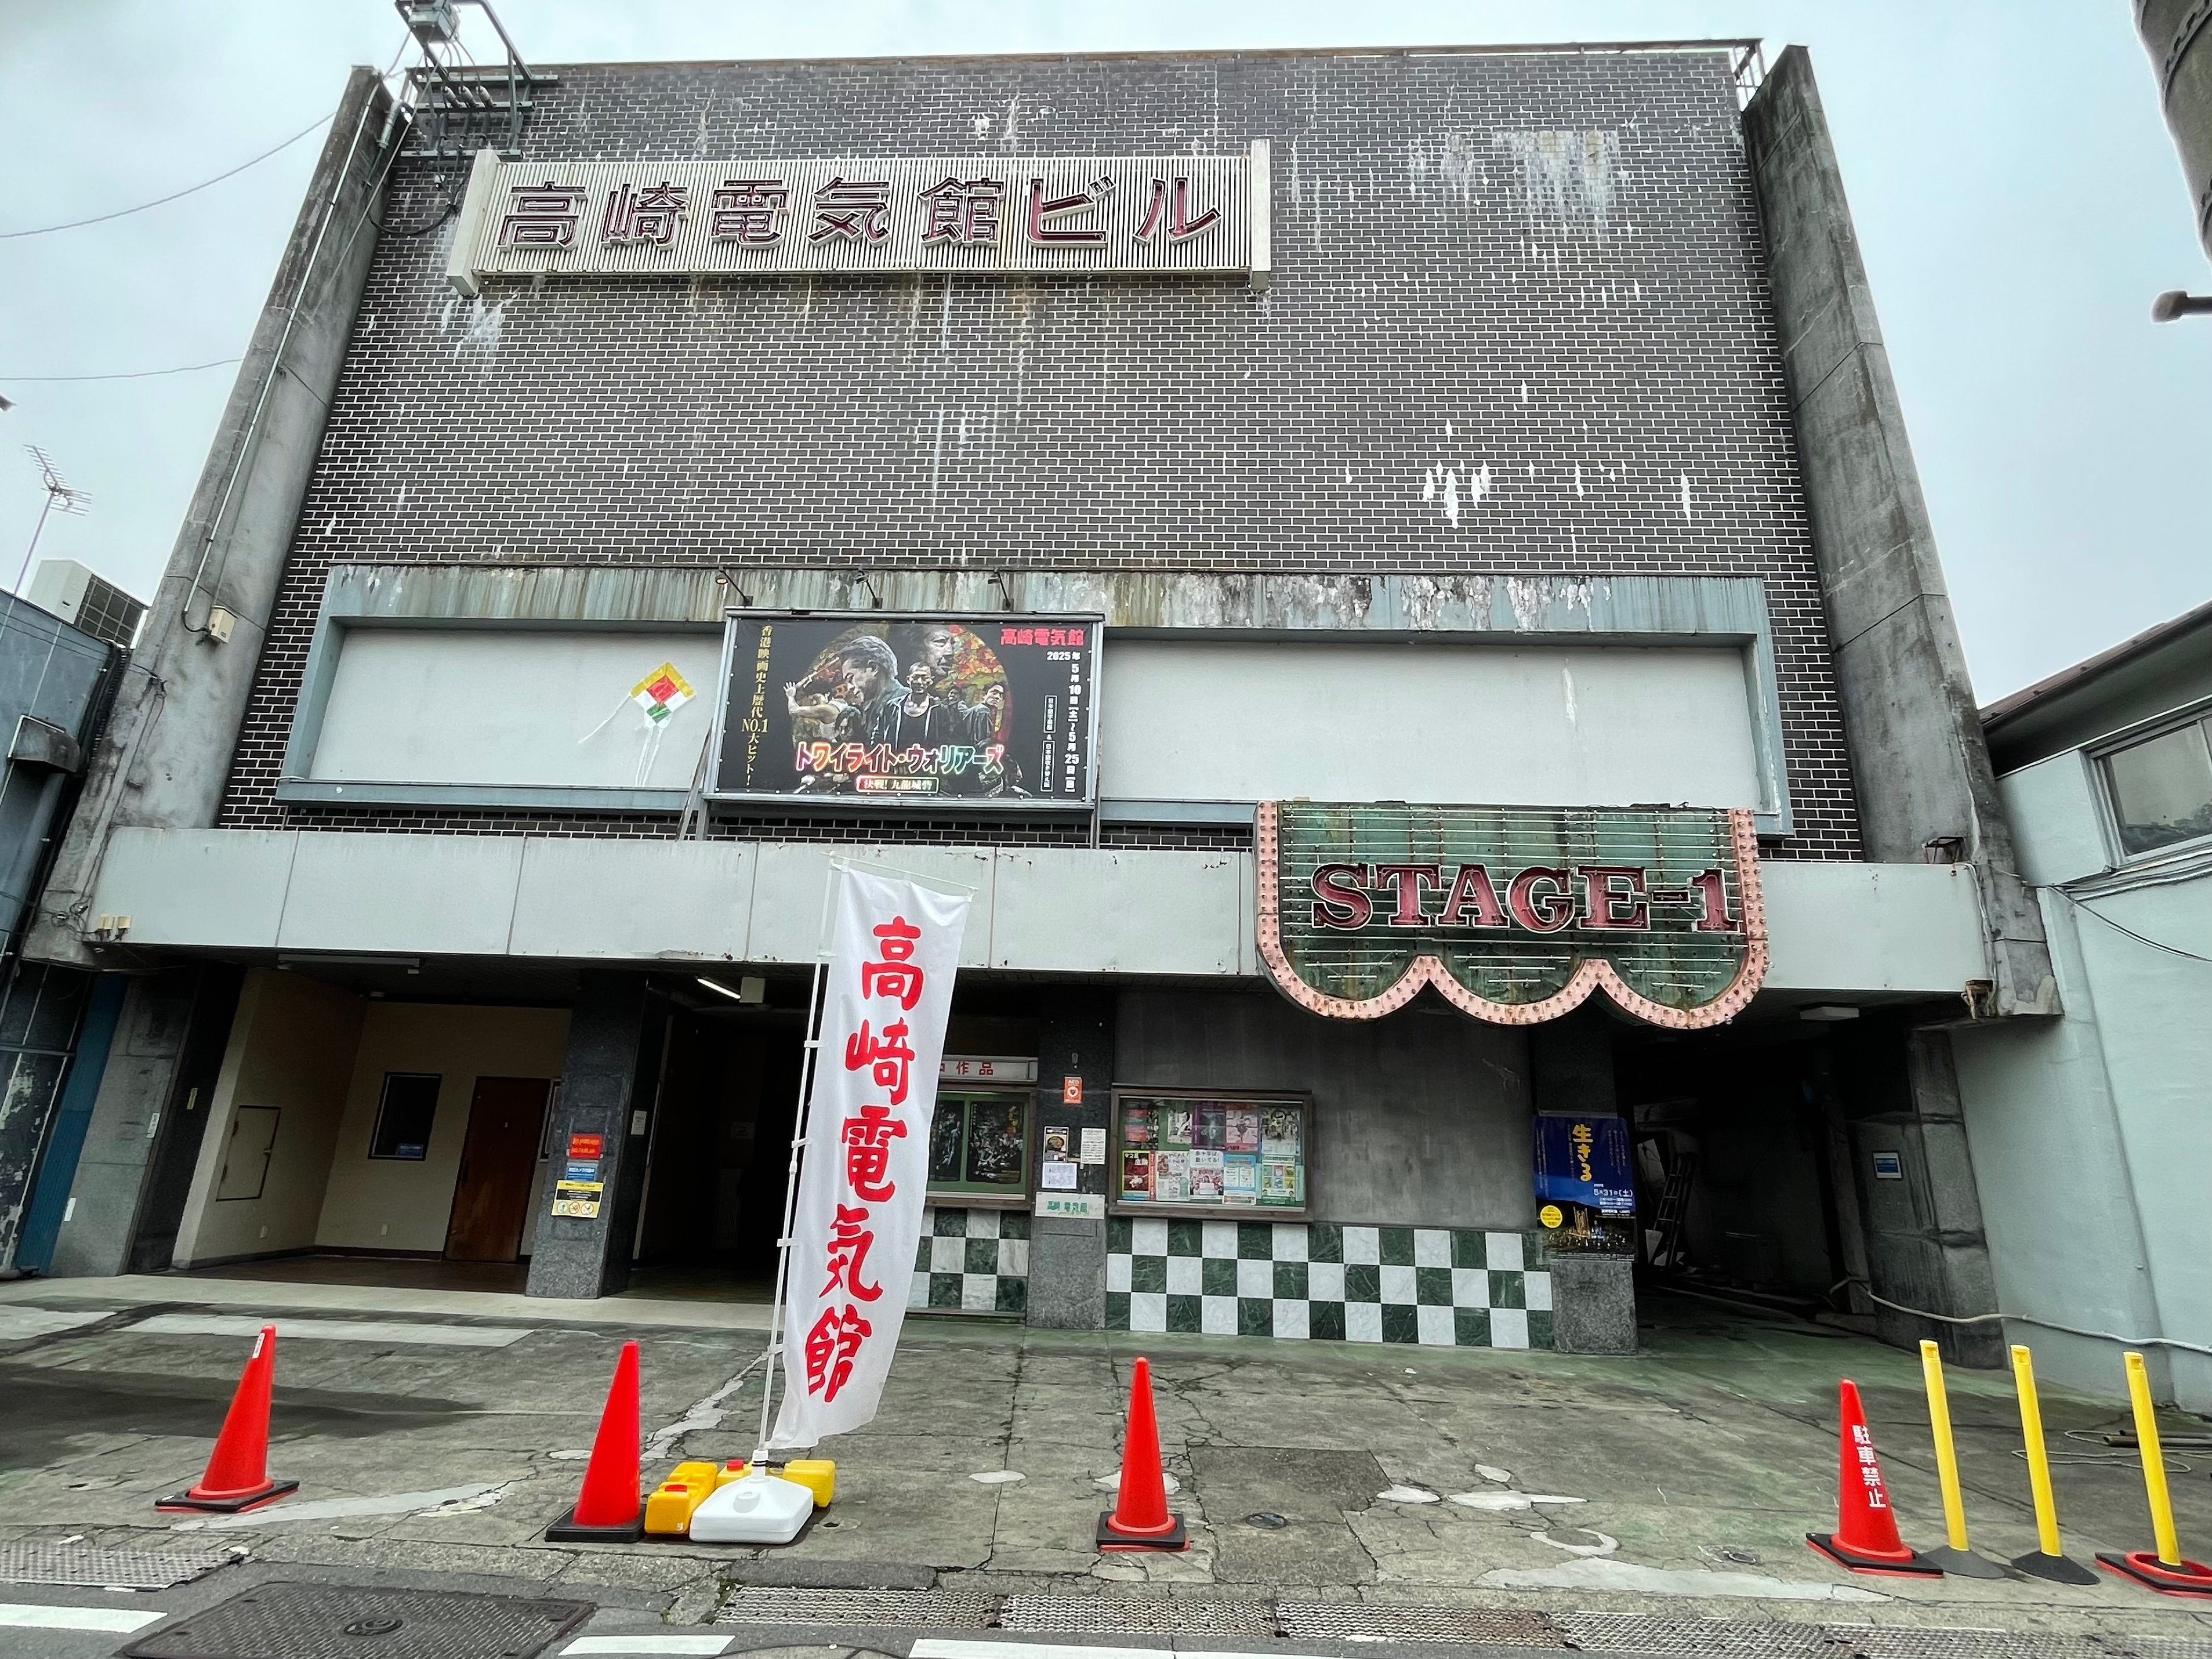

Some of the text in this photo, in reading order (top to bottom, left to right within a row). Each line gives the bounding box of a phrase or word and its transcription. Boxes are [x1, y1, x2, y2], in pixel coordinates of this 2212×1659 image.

[496, 175, 1221, 253] 高崎電気館ビル
[1000, 628, 1084, 646] 高崎電気館
[1047, 651, 1080, 661] 2025年
[796, 741, 1005, 775] トワイライト・ウォリアーズ
[1310, 863, 1740, 934] STAGE-1
[804, 916, 924, 1403] 高崎電気館
[1572, 1124, 1593, 1182] 生きる
[1852, 1425, 1886, 1508] 駐車禁止
